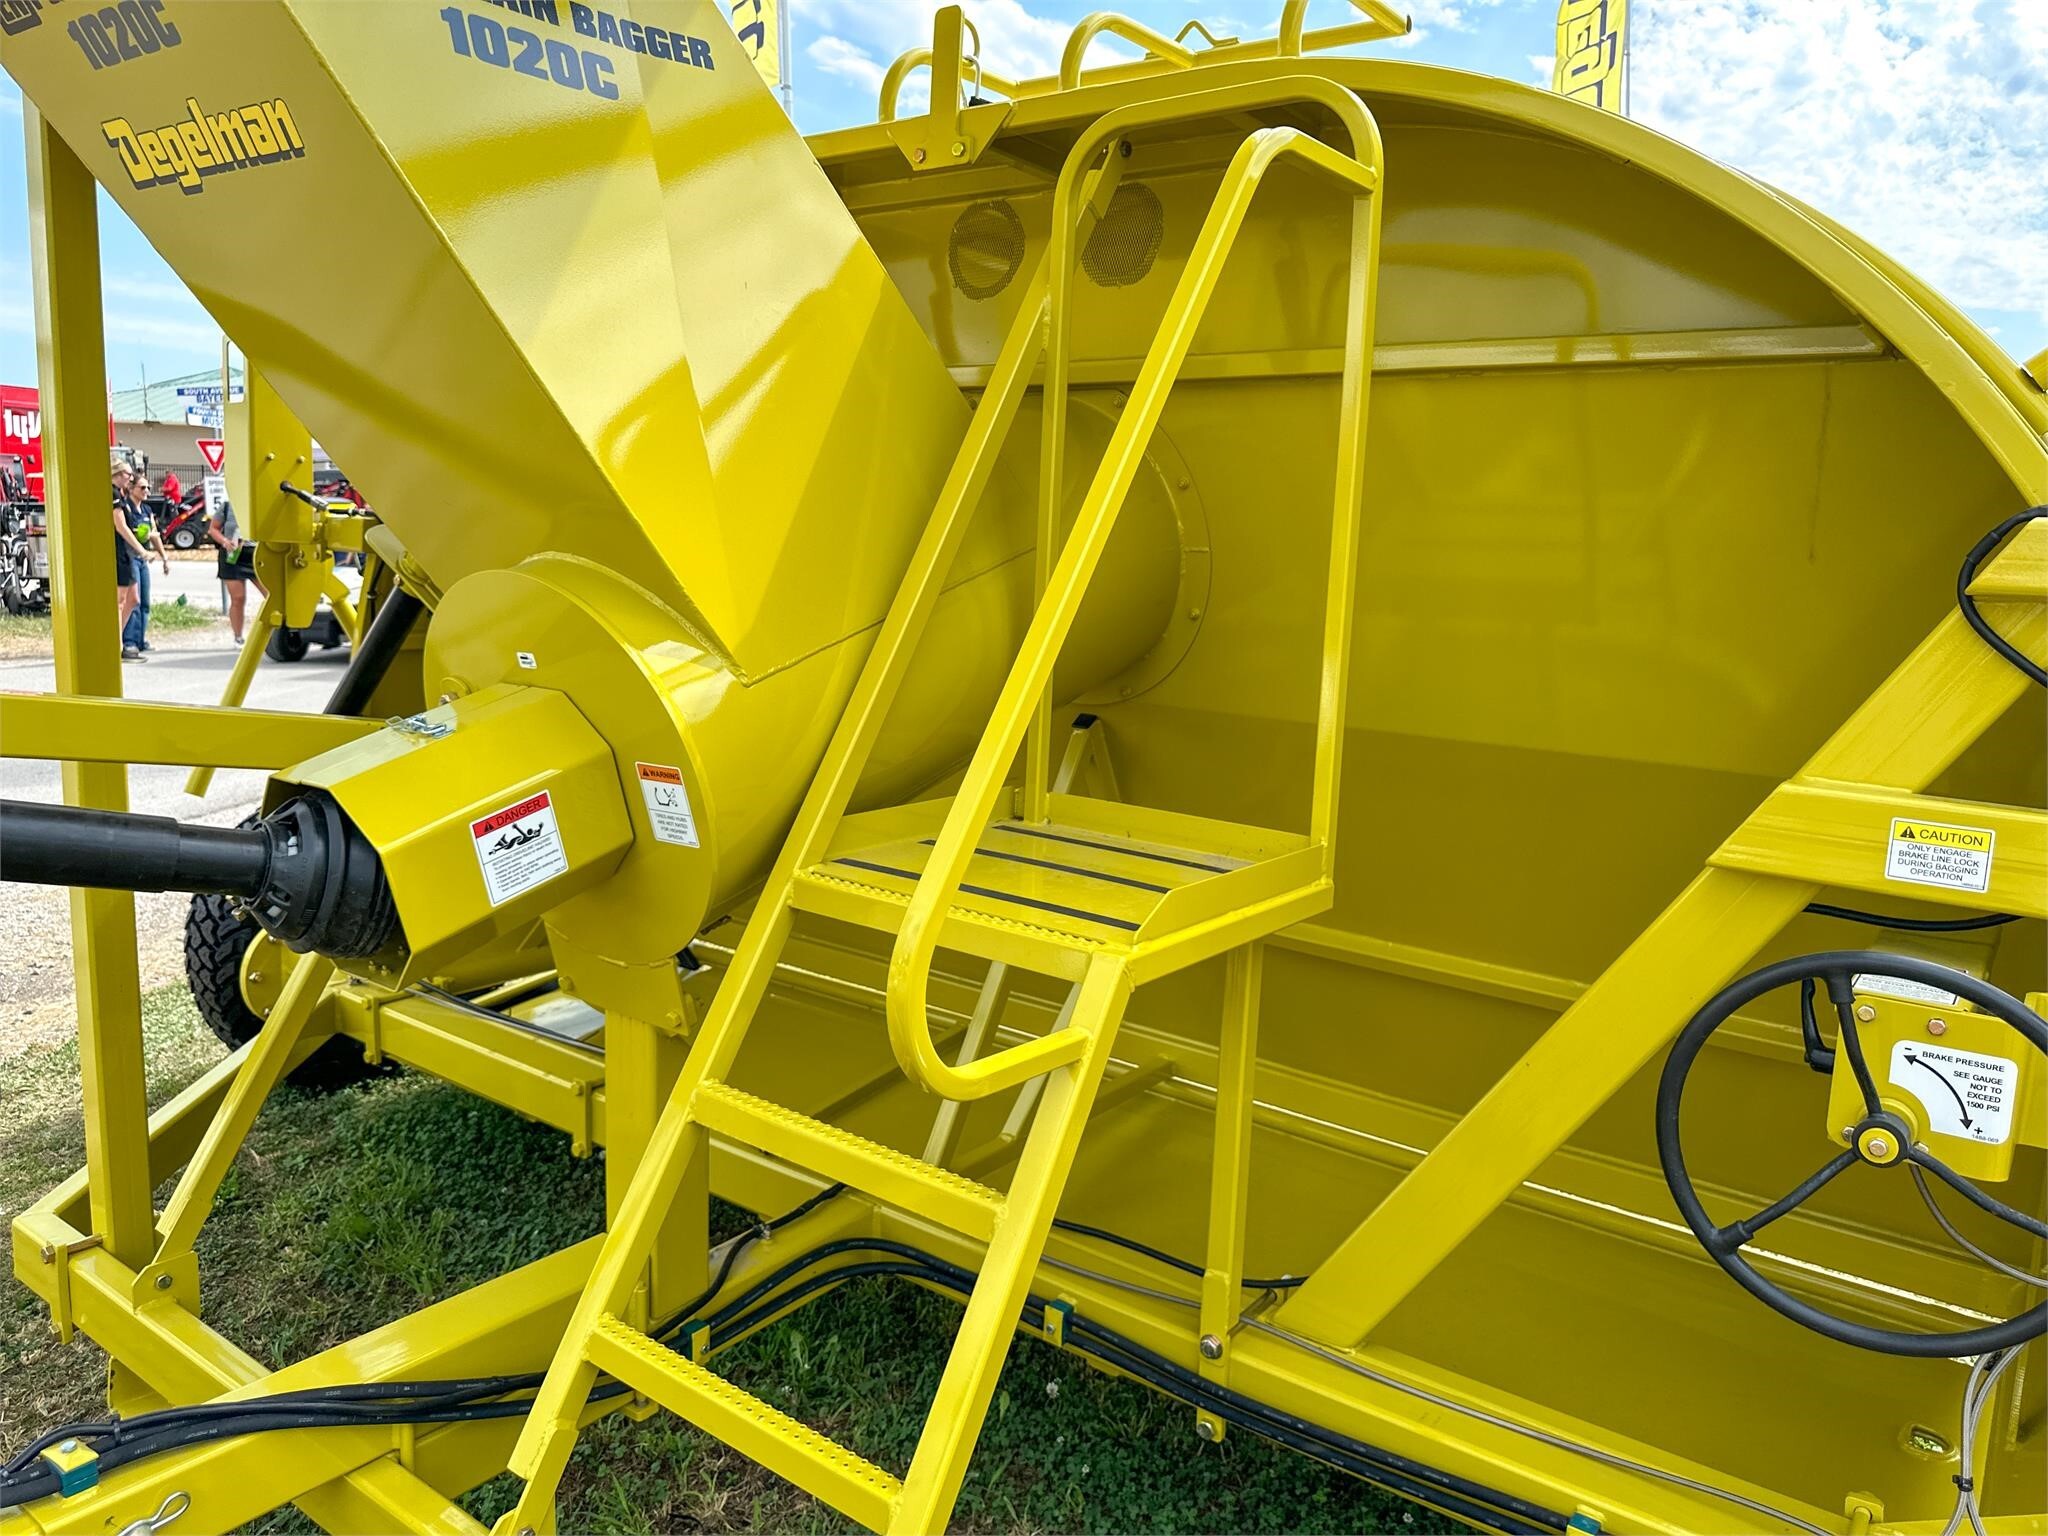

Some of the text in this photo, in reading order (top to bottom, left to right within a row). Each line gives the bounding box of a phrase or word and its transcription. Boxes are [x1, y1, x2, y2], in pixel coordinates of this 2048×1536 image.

[67, 0, 182, 71] 1020C
[569, 1, 716, 71] BAGGER
[440, 6, 620, 101] 1020C
[101, 97, 305, 195] Degelman
[649, 769, 681, 780] WARNING
[496, 799, 541, 826] DANGER
[1920, 829, 1984, 846] CAUTION
[1898, 850, 1980, 868] BRAKE LINE LOCK
[1907, 843, 1973, 858] ONLY ENGAGE
[1897, 858, 1979, 876] DURING BAGGING
[1910, 867, 1963, 881] OPERATION
[1922, 1051, 2005, 1072] BRAKE PRESSURE
[1953, 1070, 2004, 1085] SEE GAUGE
[1970, 1083, 1988, 1092] NOT
[1967, 1091, 2001, 1103] EXCEED
[1966, 1100, 2000, 1112] 1500 PSI
